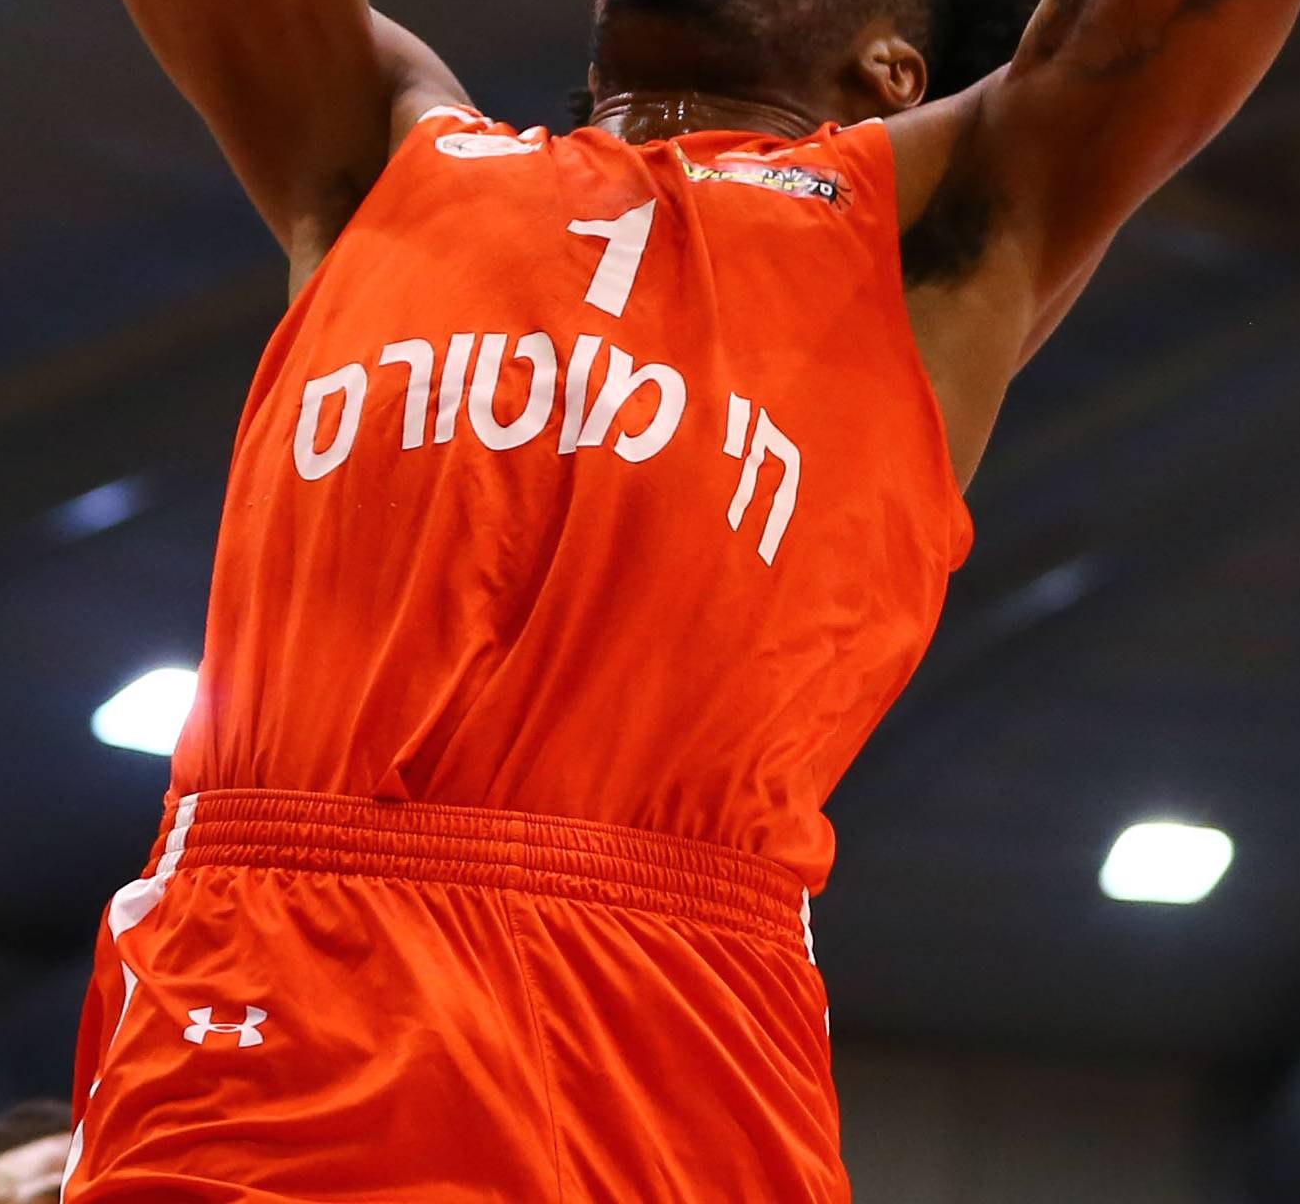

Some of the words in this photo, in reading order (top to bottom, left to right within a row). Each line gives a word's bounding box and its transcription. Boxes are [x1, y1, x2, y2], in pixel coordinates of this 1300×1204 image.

[567, 199, 657, 319] 1
[293, 331, 688, 482] מוטורס
[722, 392, 802, 567] חי
